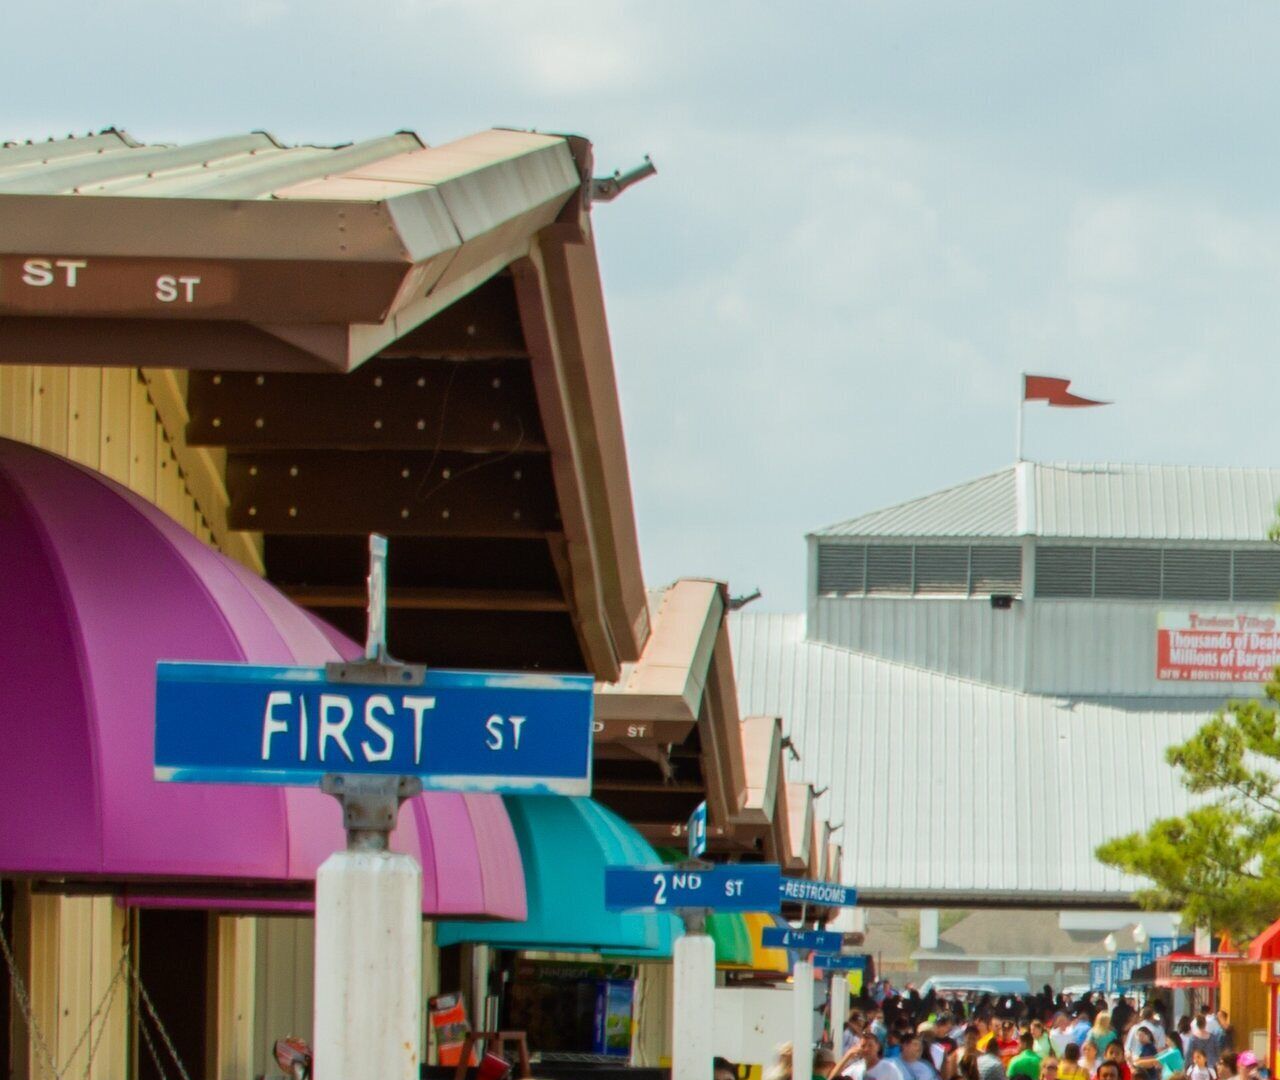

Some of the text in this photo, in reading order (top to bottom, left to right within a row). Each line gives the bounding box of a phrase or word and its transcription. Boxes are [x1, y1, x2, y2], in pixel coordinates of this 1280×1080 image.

[22, 258, 87, 287] ST
[155, 274, 201, 302] ST
[1169, 631, 1232, 649] Thousands
[1234, 632, 1247, 649] of
[1169, 648, 1218, 666] Millions
[1220, 650, 1234, 666] of
[262, 691, 526, 765] FIRST ST
[628, 725, 646, 738] ST
[653, 874, 743, 904] 2ND ST
